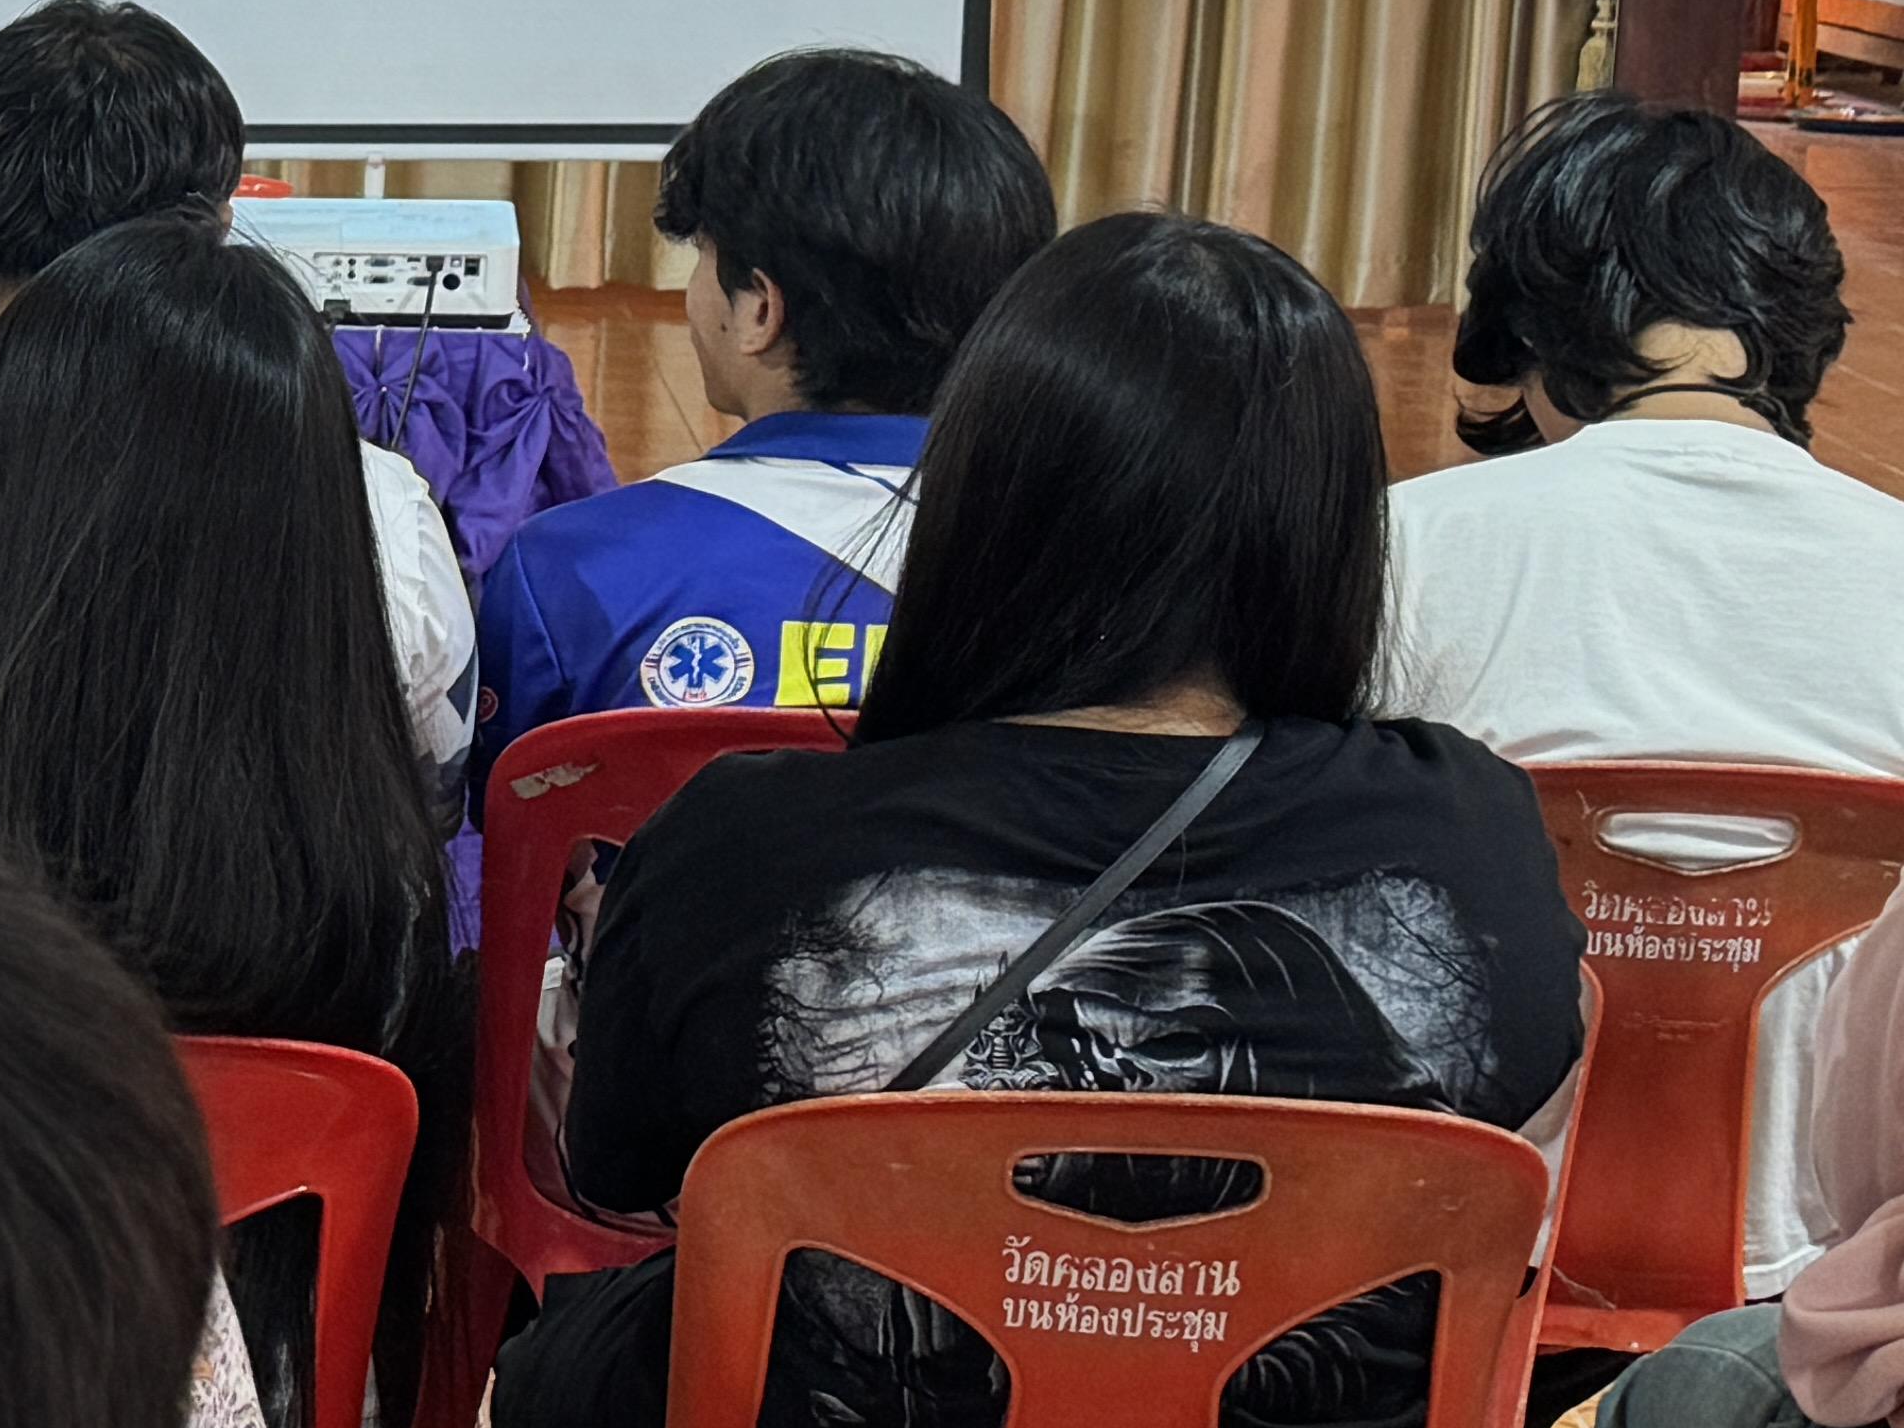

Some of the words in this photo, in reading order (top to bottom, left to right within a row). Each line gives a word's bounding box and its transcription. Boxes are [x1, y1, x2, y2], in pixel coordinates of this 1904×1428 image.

[1002, 1292, 1228, 1353] บนห้องประชุม
